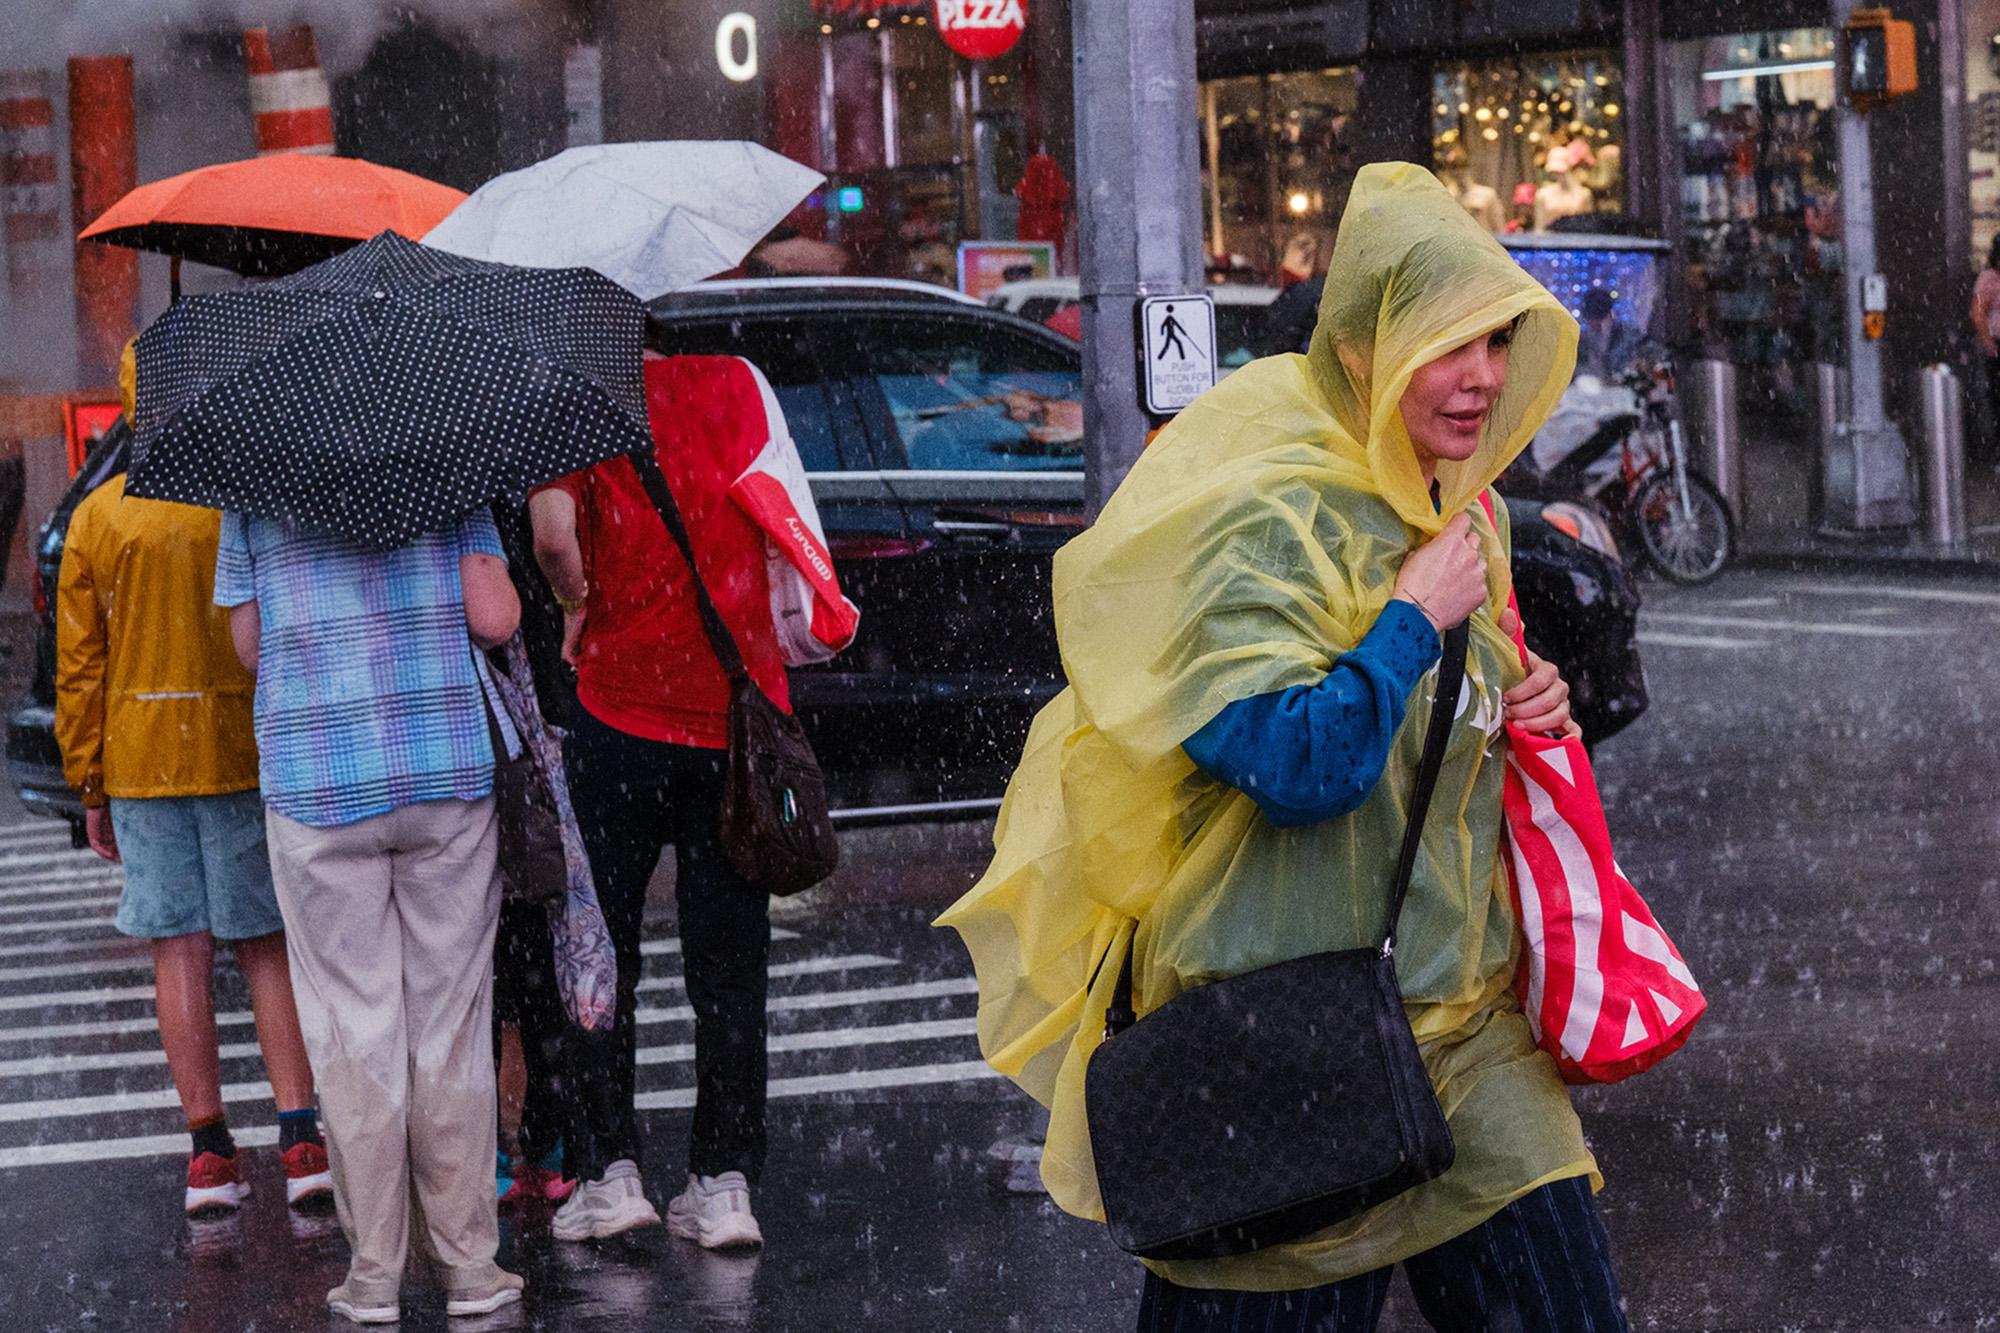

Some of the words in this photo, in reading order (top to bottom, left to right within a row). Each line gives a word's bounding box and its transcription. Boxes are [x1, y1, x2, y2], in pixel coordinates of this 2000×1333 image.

[937, 0, 1025, 31] PIZZA
[1170, 361, 1196, 372] PUSH
[1154, 373, 1190, 385] BUTTON
[1192, 371, 1210, 382] FOR
[784, 517, 817, 560] Dufry
